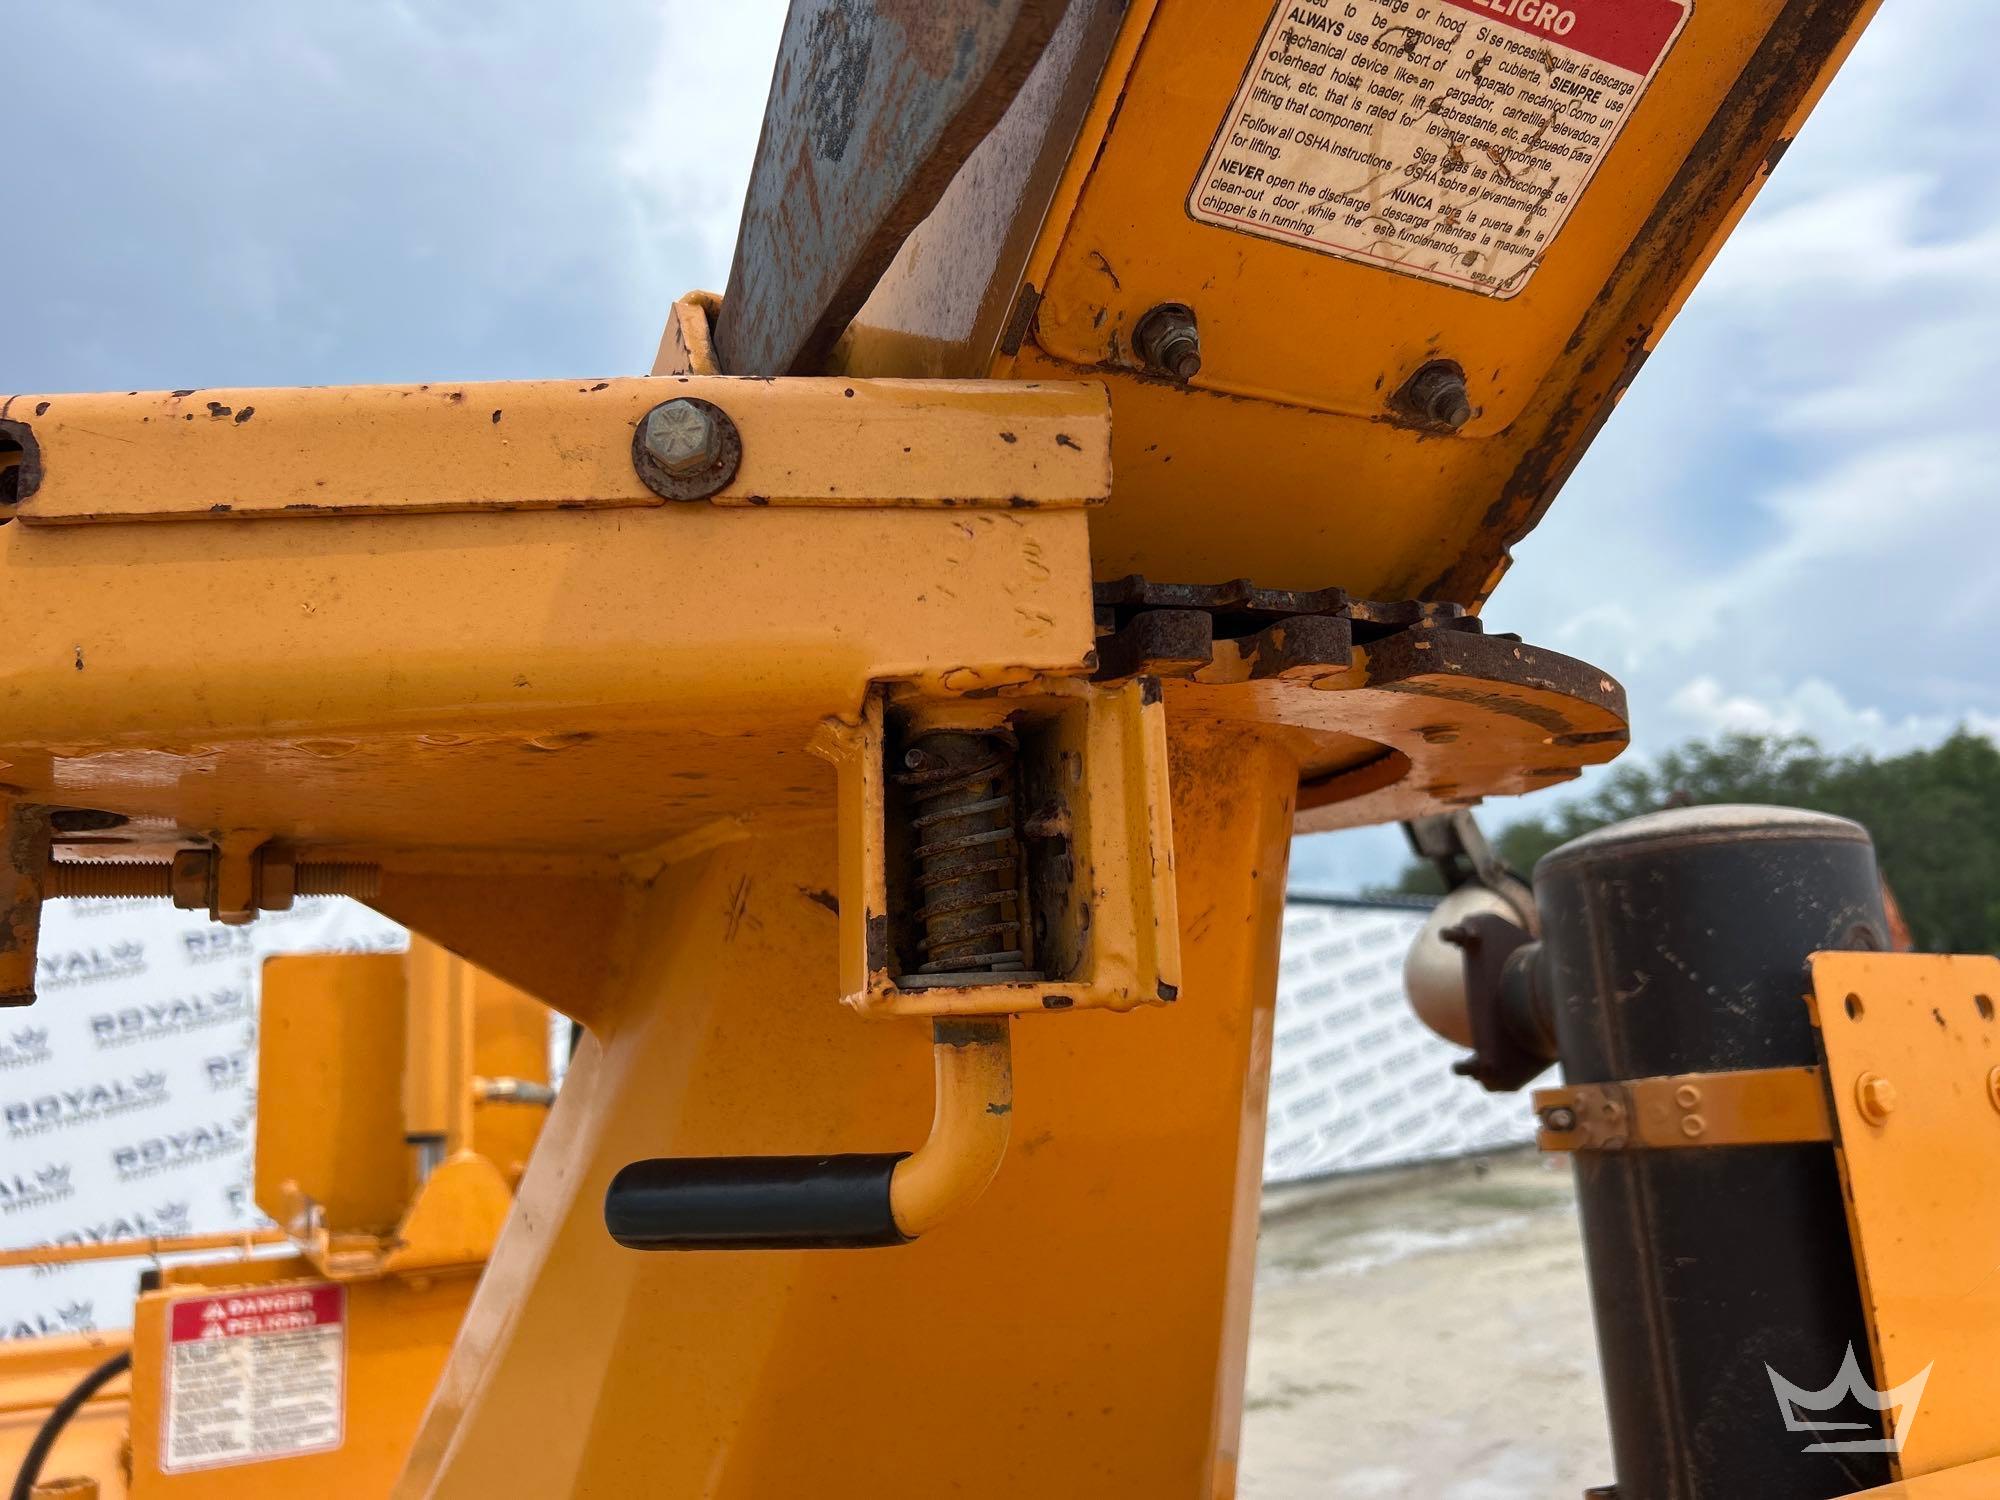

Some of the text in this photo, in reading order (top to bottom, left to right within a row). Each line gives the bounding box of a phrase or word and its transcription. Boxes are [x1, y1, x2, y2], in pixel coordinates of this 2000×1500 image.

[1288, 7, 1448, 72] ALWAYS use some sort of
[1344, 3, 1356, 17] to
[1372, 12, 1387, 28] be
[1401, 26, 1457, 54] removed,
[1416, 8, 1430, 20] or
[1436, 12, 1467, 33] hood
[1472, 0, 1576, 36] LIGRO
[1270, 51, 1426, 110] overhead hoist, loader, lift
[1279, 30, 1434, 91] mechanical device like an
[1466, 50, 1623, 112] o la cubierta, SIEMPRE use
[1477, 27, 1491, 42] Si
[1489, 35, 1503, 47] se
[1504, 40, 1550, 64] necesita
[1578, 65, 1592, 78] la
[1590, 70, 1634, 95] descarga
[1252, 86, 1373, 136] lifting that component.
[1261, 68, 1416, 127] truck, etc. that is rated for
[1443, 88, 1494, 113] cargador,
[1553, 124, 1600, 148] elevadora,
[1456, 68, 1471, 81] un
[1474, 74, 1514, 96] aparato
[1570, 108, 1597, 124] como
[1600, 119, 1613, 130] un
[1231, 133, 1280, 160] for lifting.
[1240, 113, 1392, 170] Follow all OSHA instructions
[1426, 121, 1470, 146] levantar
[1471, 138, 1489, 151] ese
[1436, 104, 1497, 136] cabrestante,
[1501, 127, 1518, 140] etc.
[1568, 148, 1592, 163] para
[1219, 158, 1370, 212] NEVER open the discharge
[1405, 165, 1547, 217] OSHA sobre el levantamiento.
[1413, 147, 1437, 166] Siga
[1471, 165, 1487, 179] las
[1489, 171, 1554, 199] instrucciones
[1555, 192, 1567, 203] de
[1203, 196, 1314, 236] chipper is in running.
[1211, 178, 1362, 228] clean-out door while the
[1391, 188, 1432, 210] NUNCA
[1438, 204, 1462, 218] abra
[1466, 210, 1476, 223] la
[1480, 218, 1513, 233] puerta
[1534, 231, 1544, 242] la
[1382, 207, 1535, 257] descarga mientras la maquina
[91, 995, 213, 1033] ROYAL
[5, 1081, 135, 1126] ROYAL
[113, 1123, 234, 1167] ROYAL
